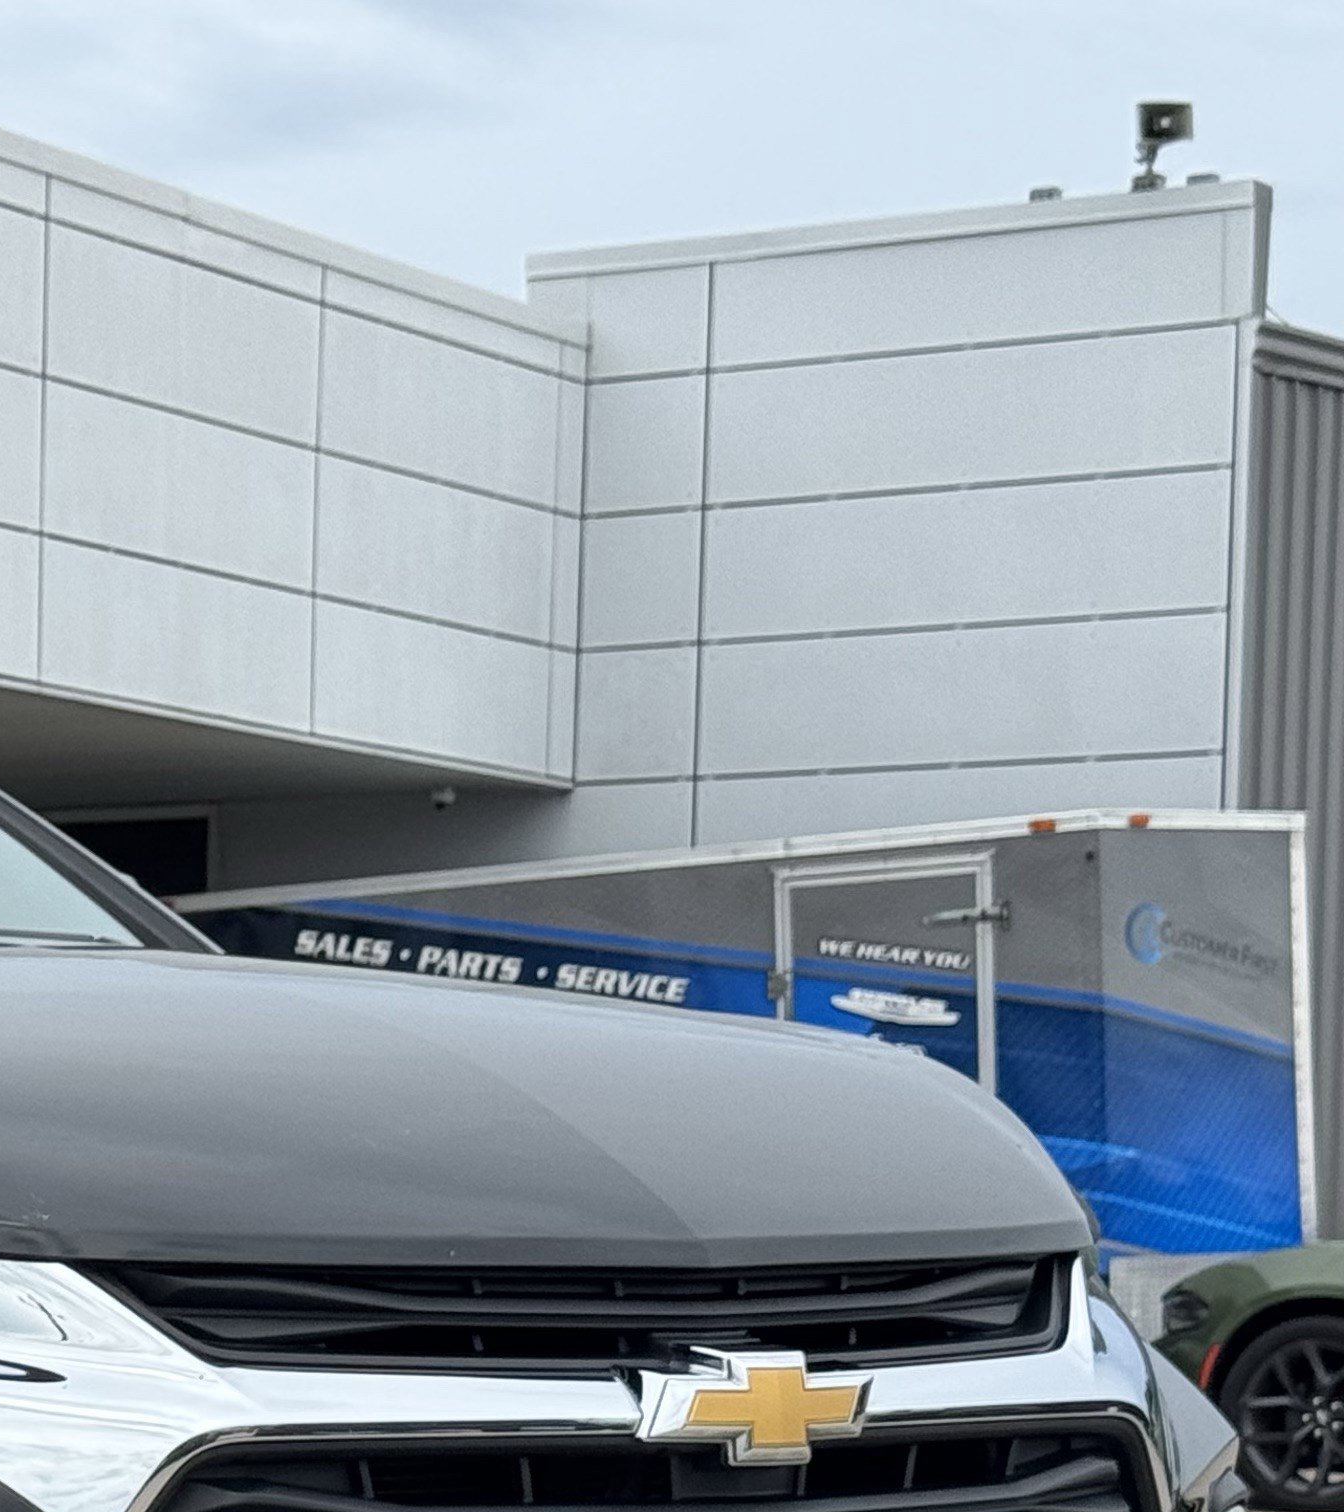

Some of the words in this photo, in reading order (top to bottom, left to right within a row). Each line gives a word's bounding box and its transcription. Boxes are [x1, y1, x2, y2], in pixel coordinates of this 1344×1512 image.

[294, 929, 393, 967] SALES
[417, 945, 523, 982] PARTS
[555, 963, 690, 1003] SERVICE
[819, 937, 857, 959] WE
[857, 942, 921, 965] HEAR
[924, 951, 971, 970] YOU
